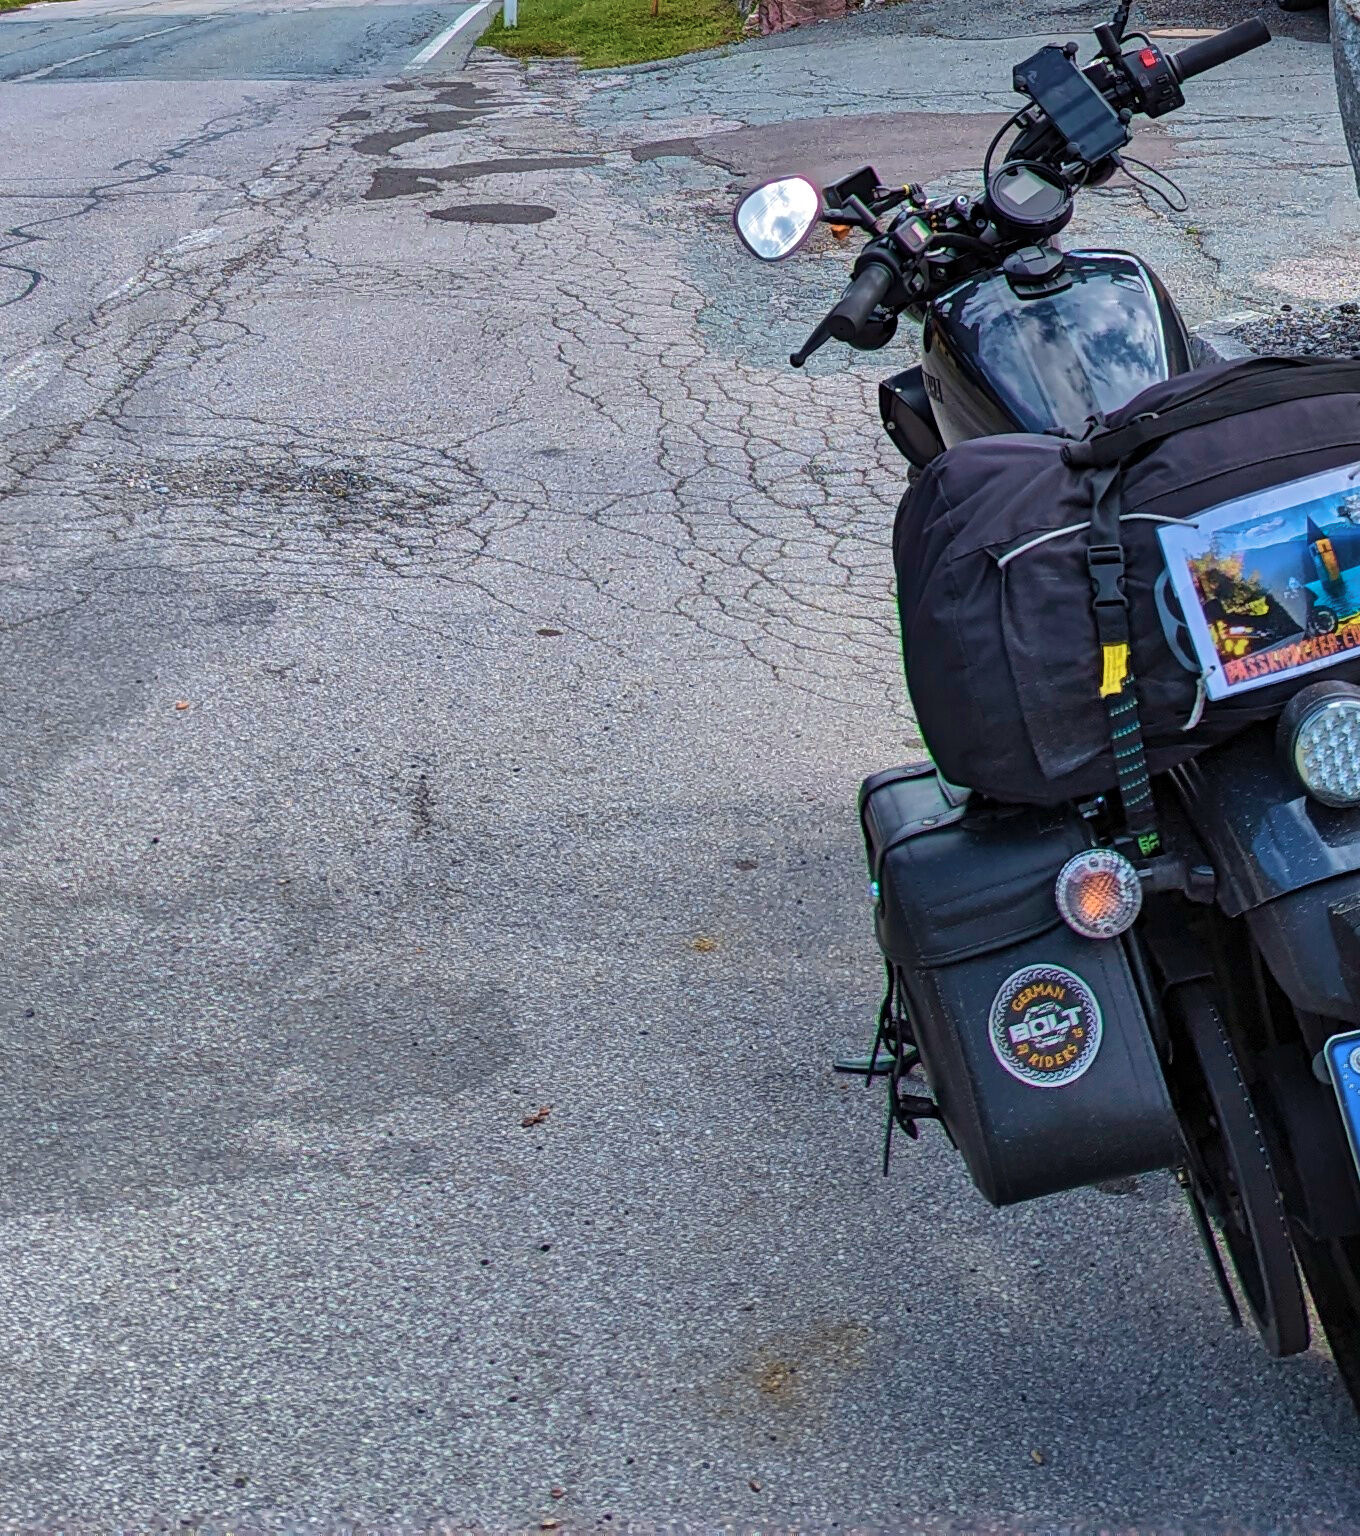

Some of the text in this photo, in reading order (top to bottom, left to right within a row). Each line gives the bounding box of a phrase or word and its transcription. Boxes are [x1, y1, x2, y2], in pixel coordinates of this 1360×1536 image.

[1011, 983, 1067, 1012] GERMAN
[1008, 1005, 1083, 1044] BOLT
[1028, 1043, 1079, 1068] RIDERS
